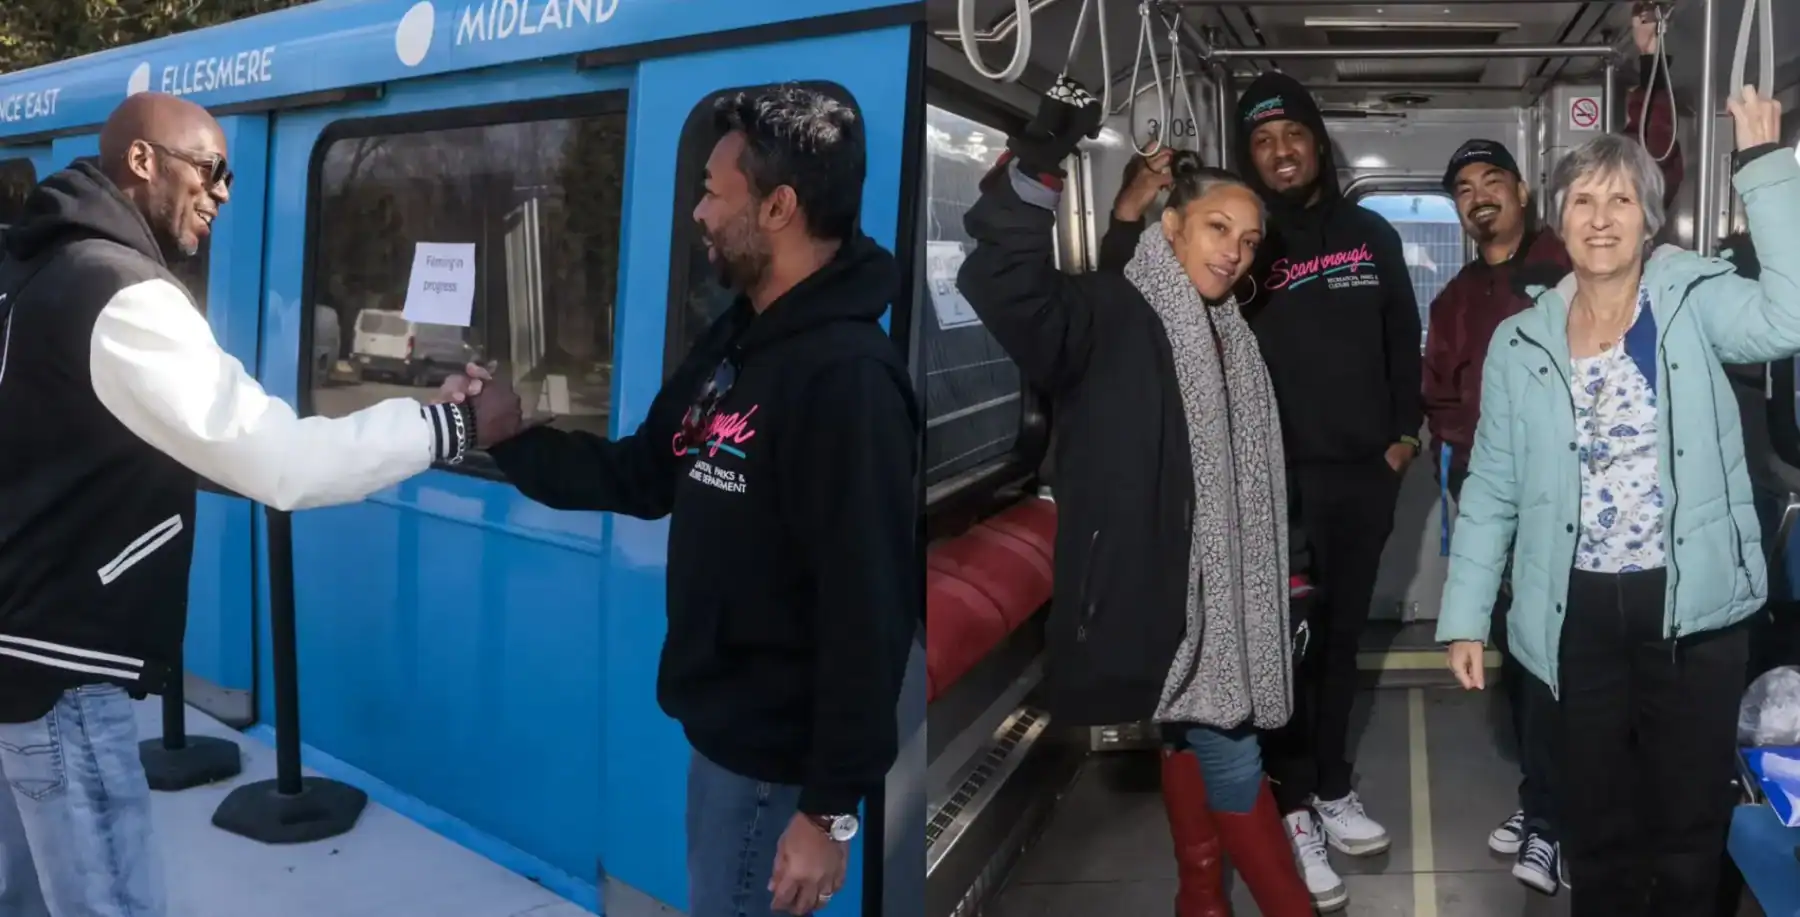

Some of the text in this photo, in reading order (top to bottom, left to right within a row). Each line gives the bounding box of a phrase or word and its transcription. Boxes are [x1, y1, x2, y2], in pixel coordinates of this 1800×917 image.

[456, 0, 619, 45] MIDLAND
[161, 46, 276, 96] ELLESMERE
[25, 88, 61, 119] EAST
[1147, 118, 1197, 137] 308
[703, 473, 747, 493] DEPARTMENT
[714, 466, 735, 481] PARKS
[738, 473, 746, 483] &
